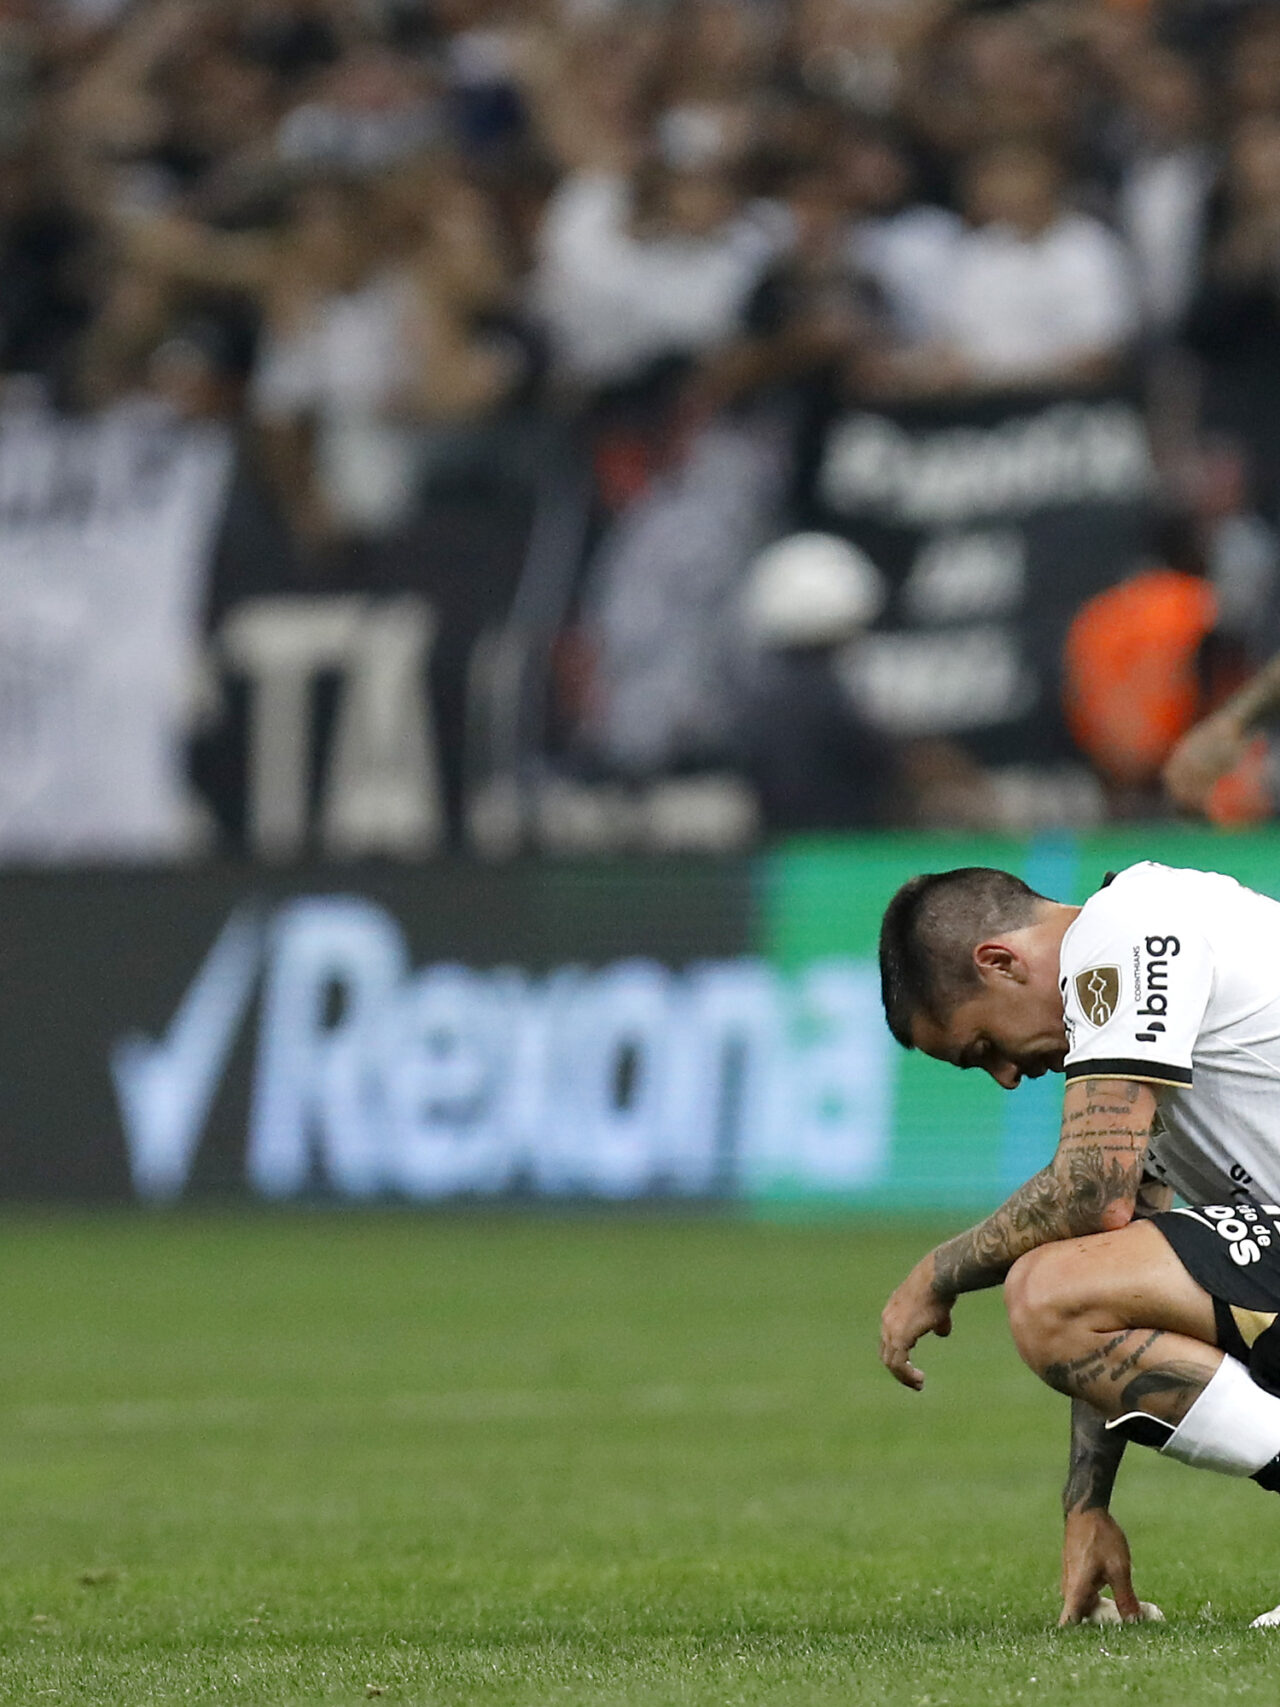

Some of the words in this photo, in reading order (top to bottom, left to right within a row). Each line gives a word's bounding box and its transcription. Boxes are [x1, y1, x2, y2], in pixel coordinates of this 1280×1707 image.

[1133, 945, 1142, 1002] CORINTHIANS
[1137, 935, 1181, 1016] bmg
[244, 892, 893, 1197] Rexona
